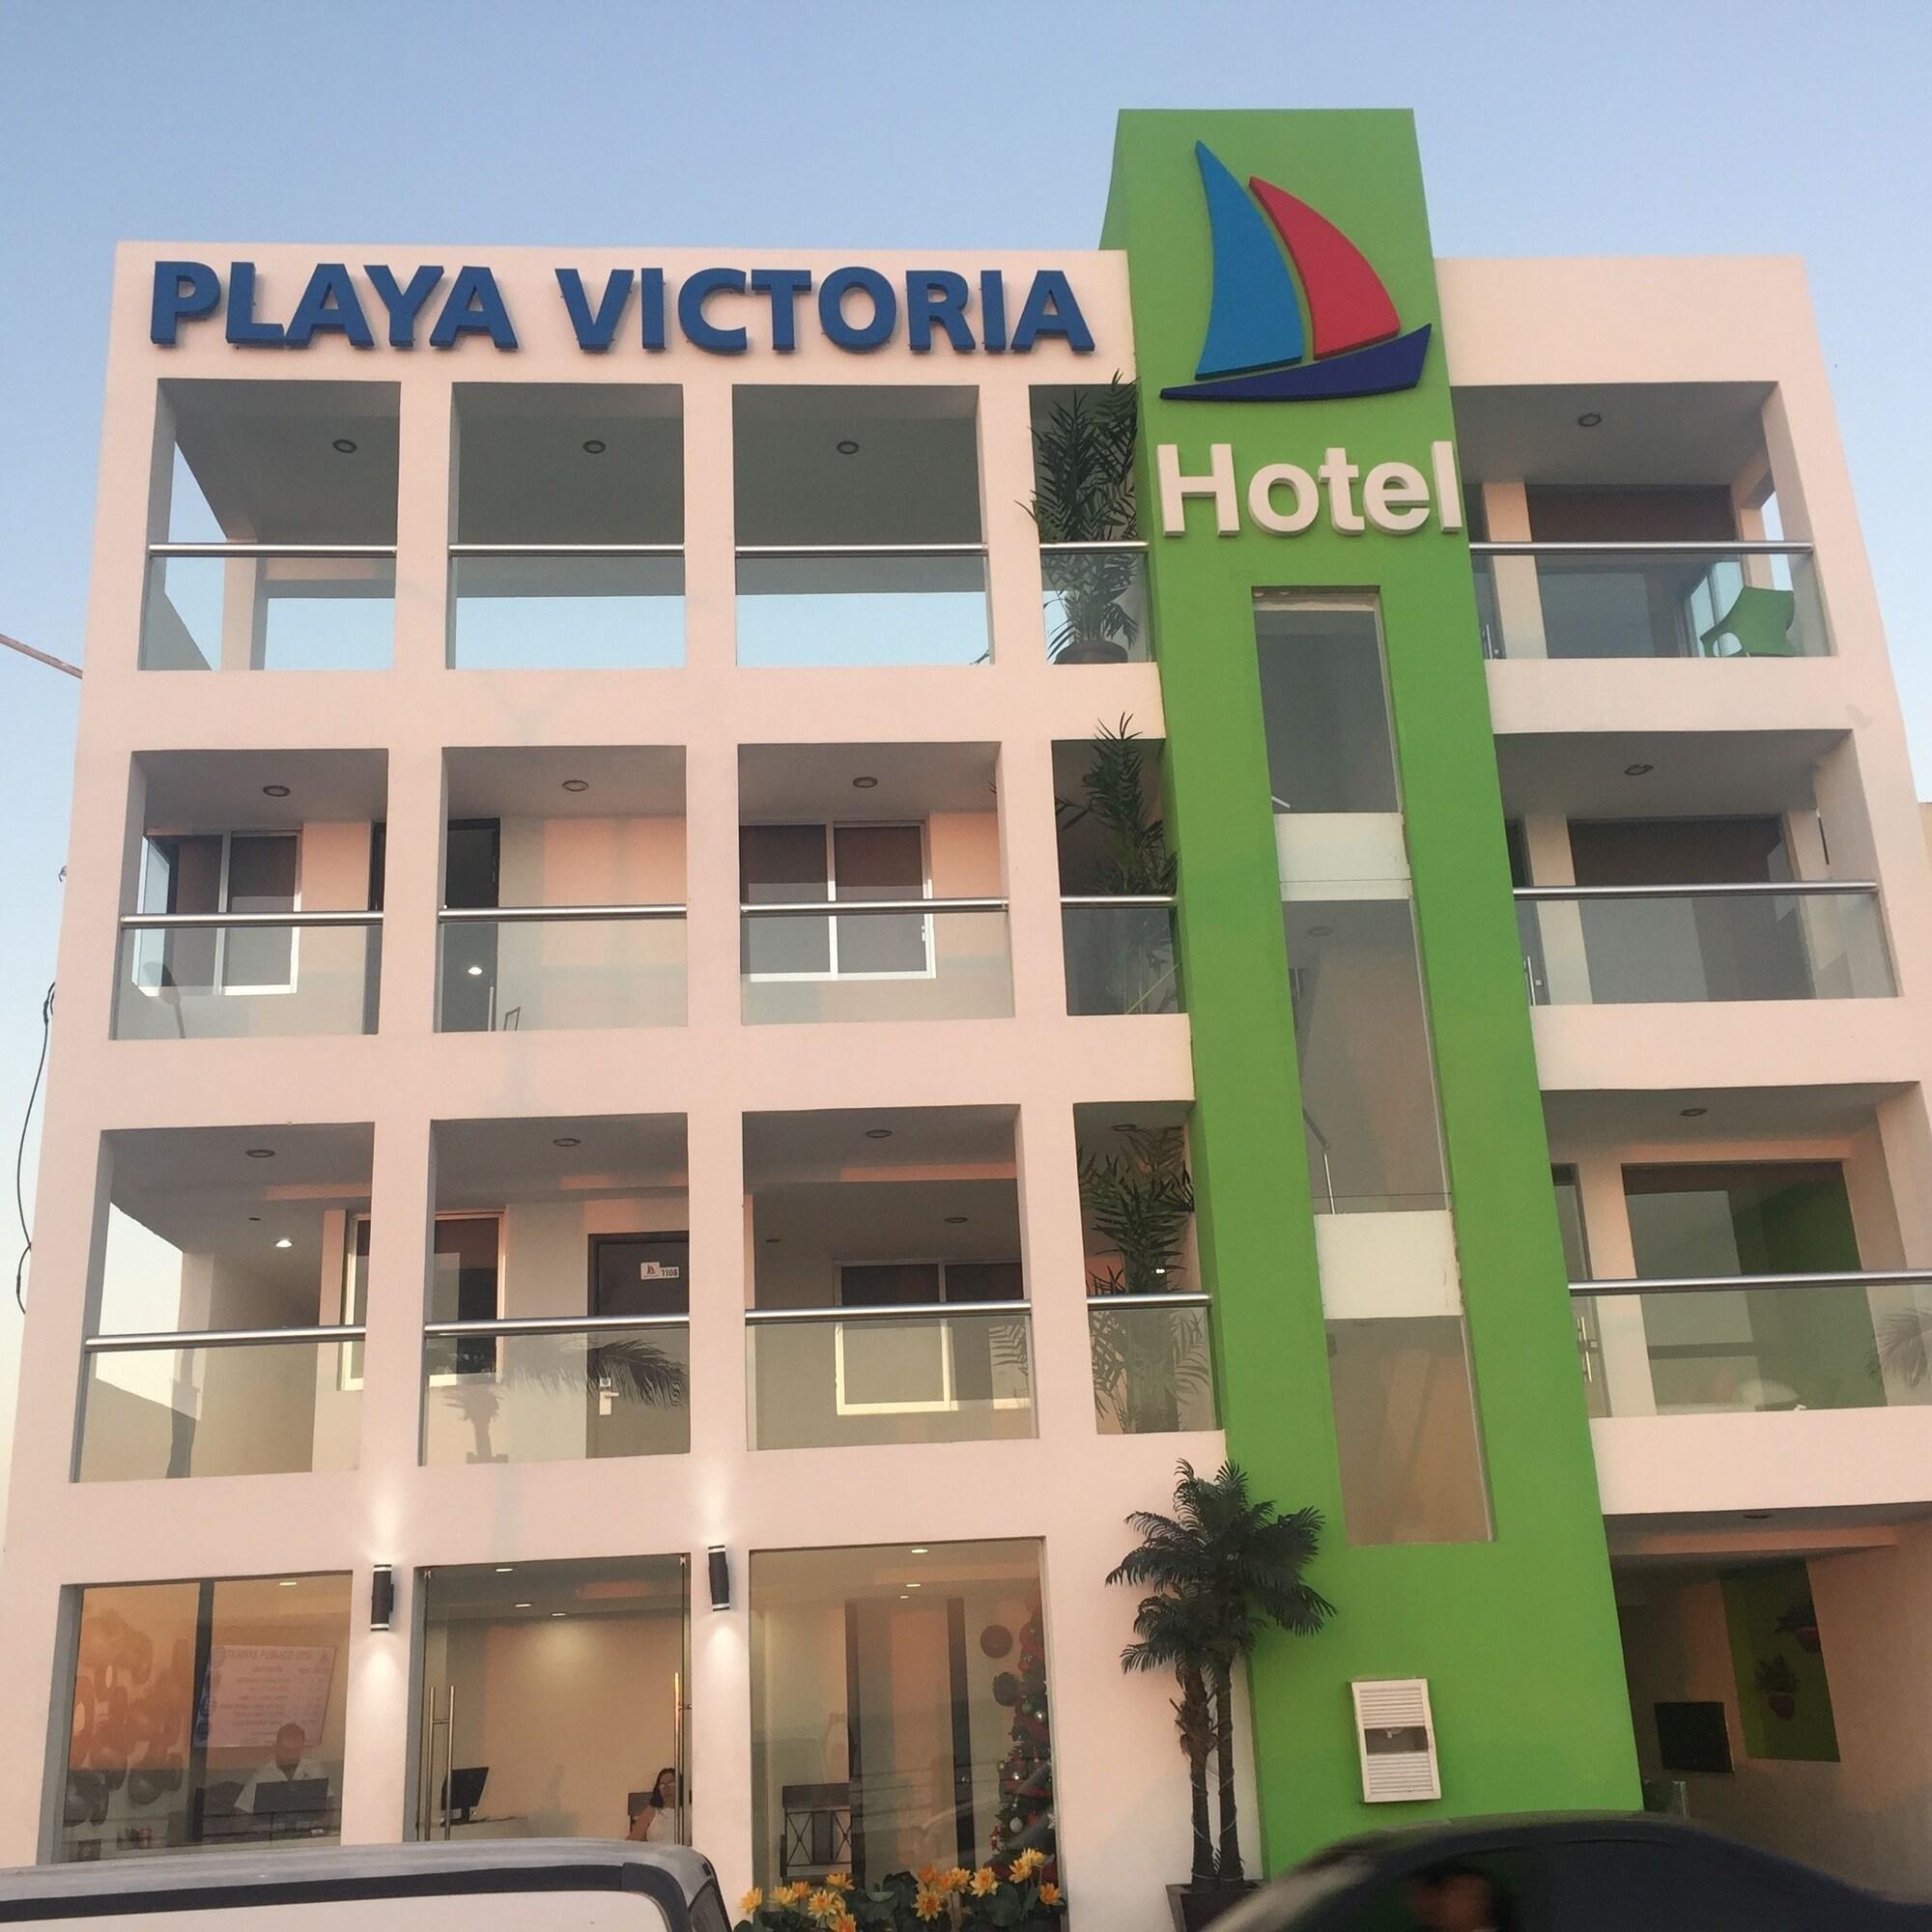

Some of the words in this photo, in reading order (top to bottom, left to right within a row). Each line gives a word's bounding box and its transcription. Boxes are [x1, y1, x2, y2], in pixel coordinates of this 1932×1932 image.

[152, 263, 516, 348] PLAYA
[556, 268, 1092, 351] VICTORIA
[1156, 440, 1463, 536] Hotel
